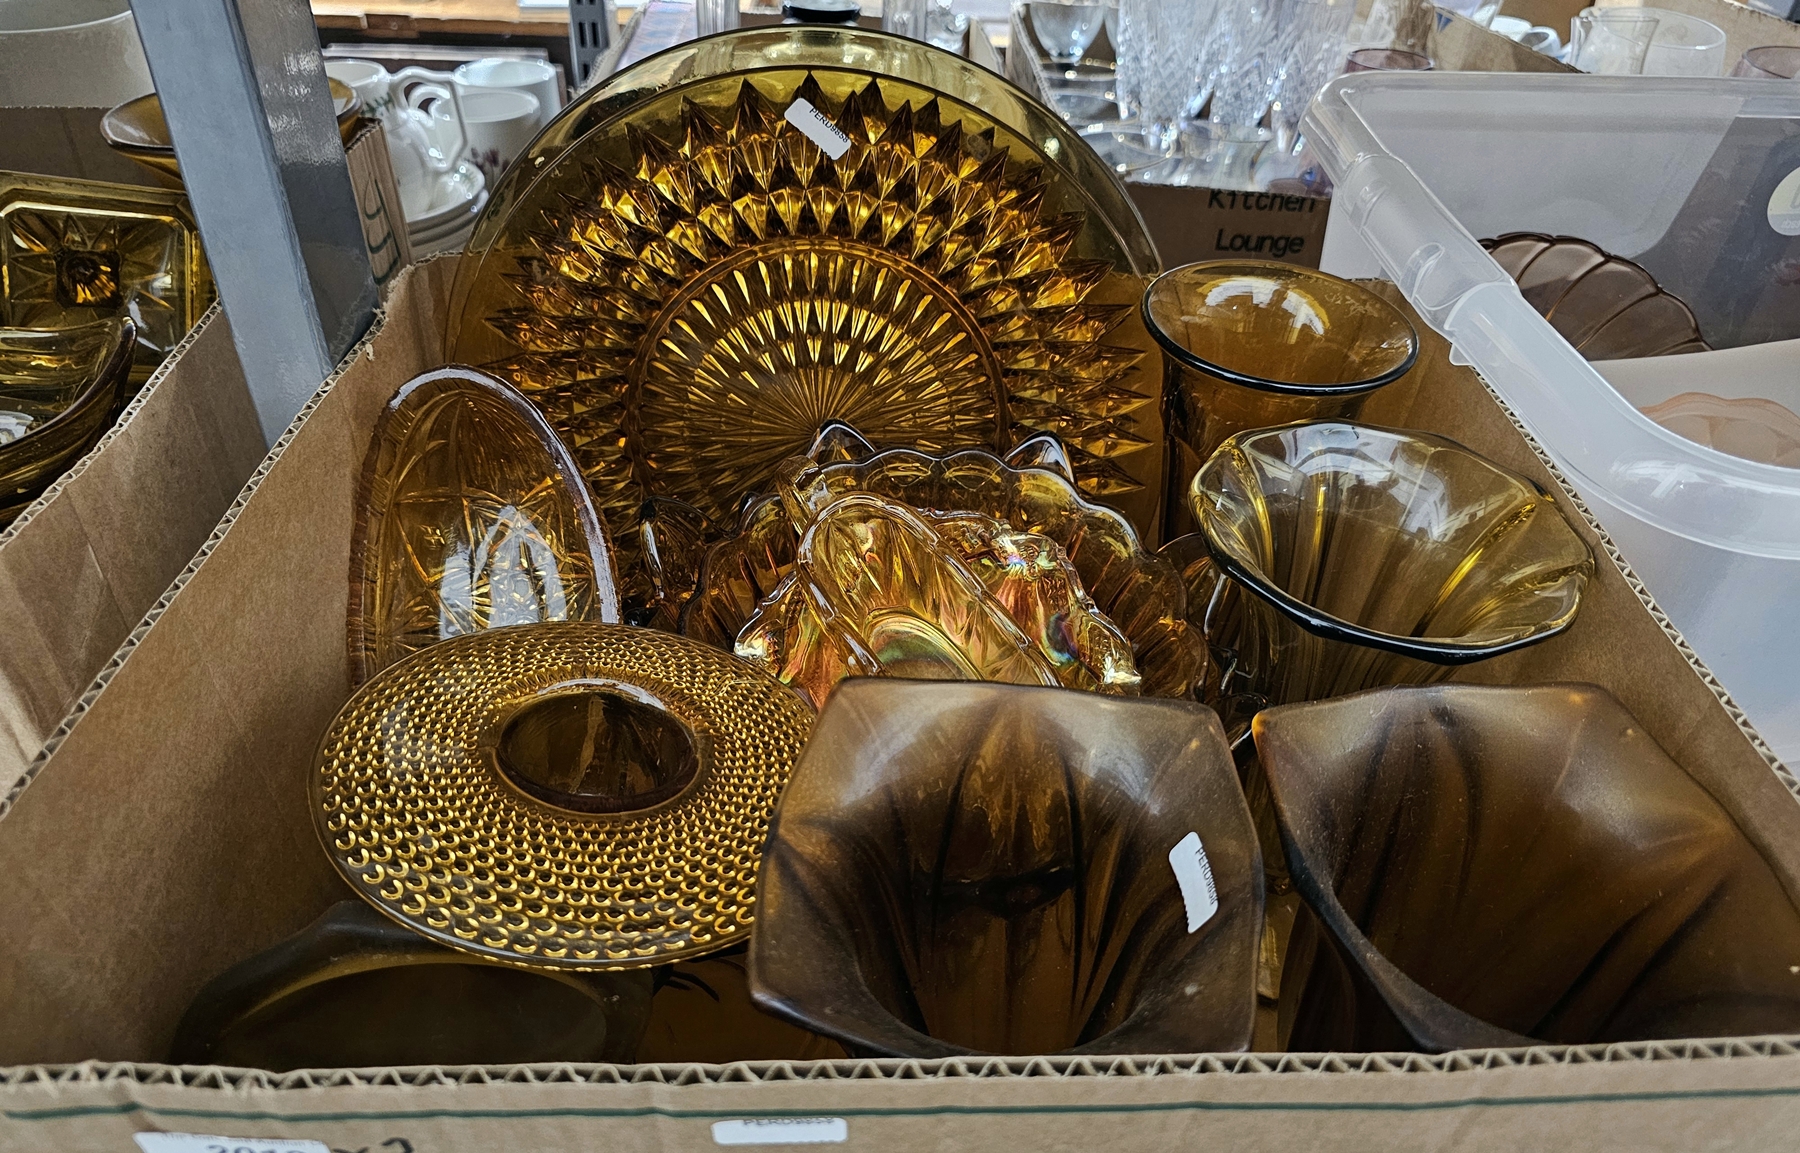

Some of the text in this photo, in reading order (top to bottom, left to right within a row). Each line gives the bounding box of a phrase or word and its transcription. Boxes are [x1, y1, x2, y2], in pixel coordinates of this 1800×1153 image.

[809, 107, 848, 143] PERD9858
[1208, 188, 1316, 213] Kitchen
[1215, 228, 1305, 258] Lounge
